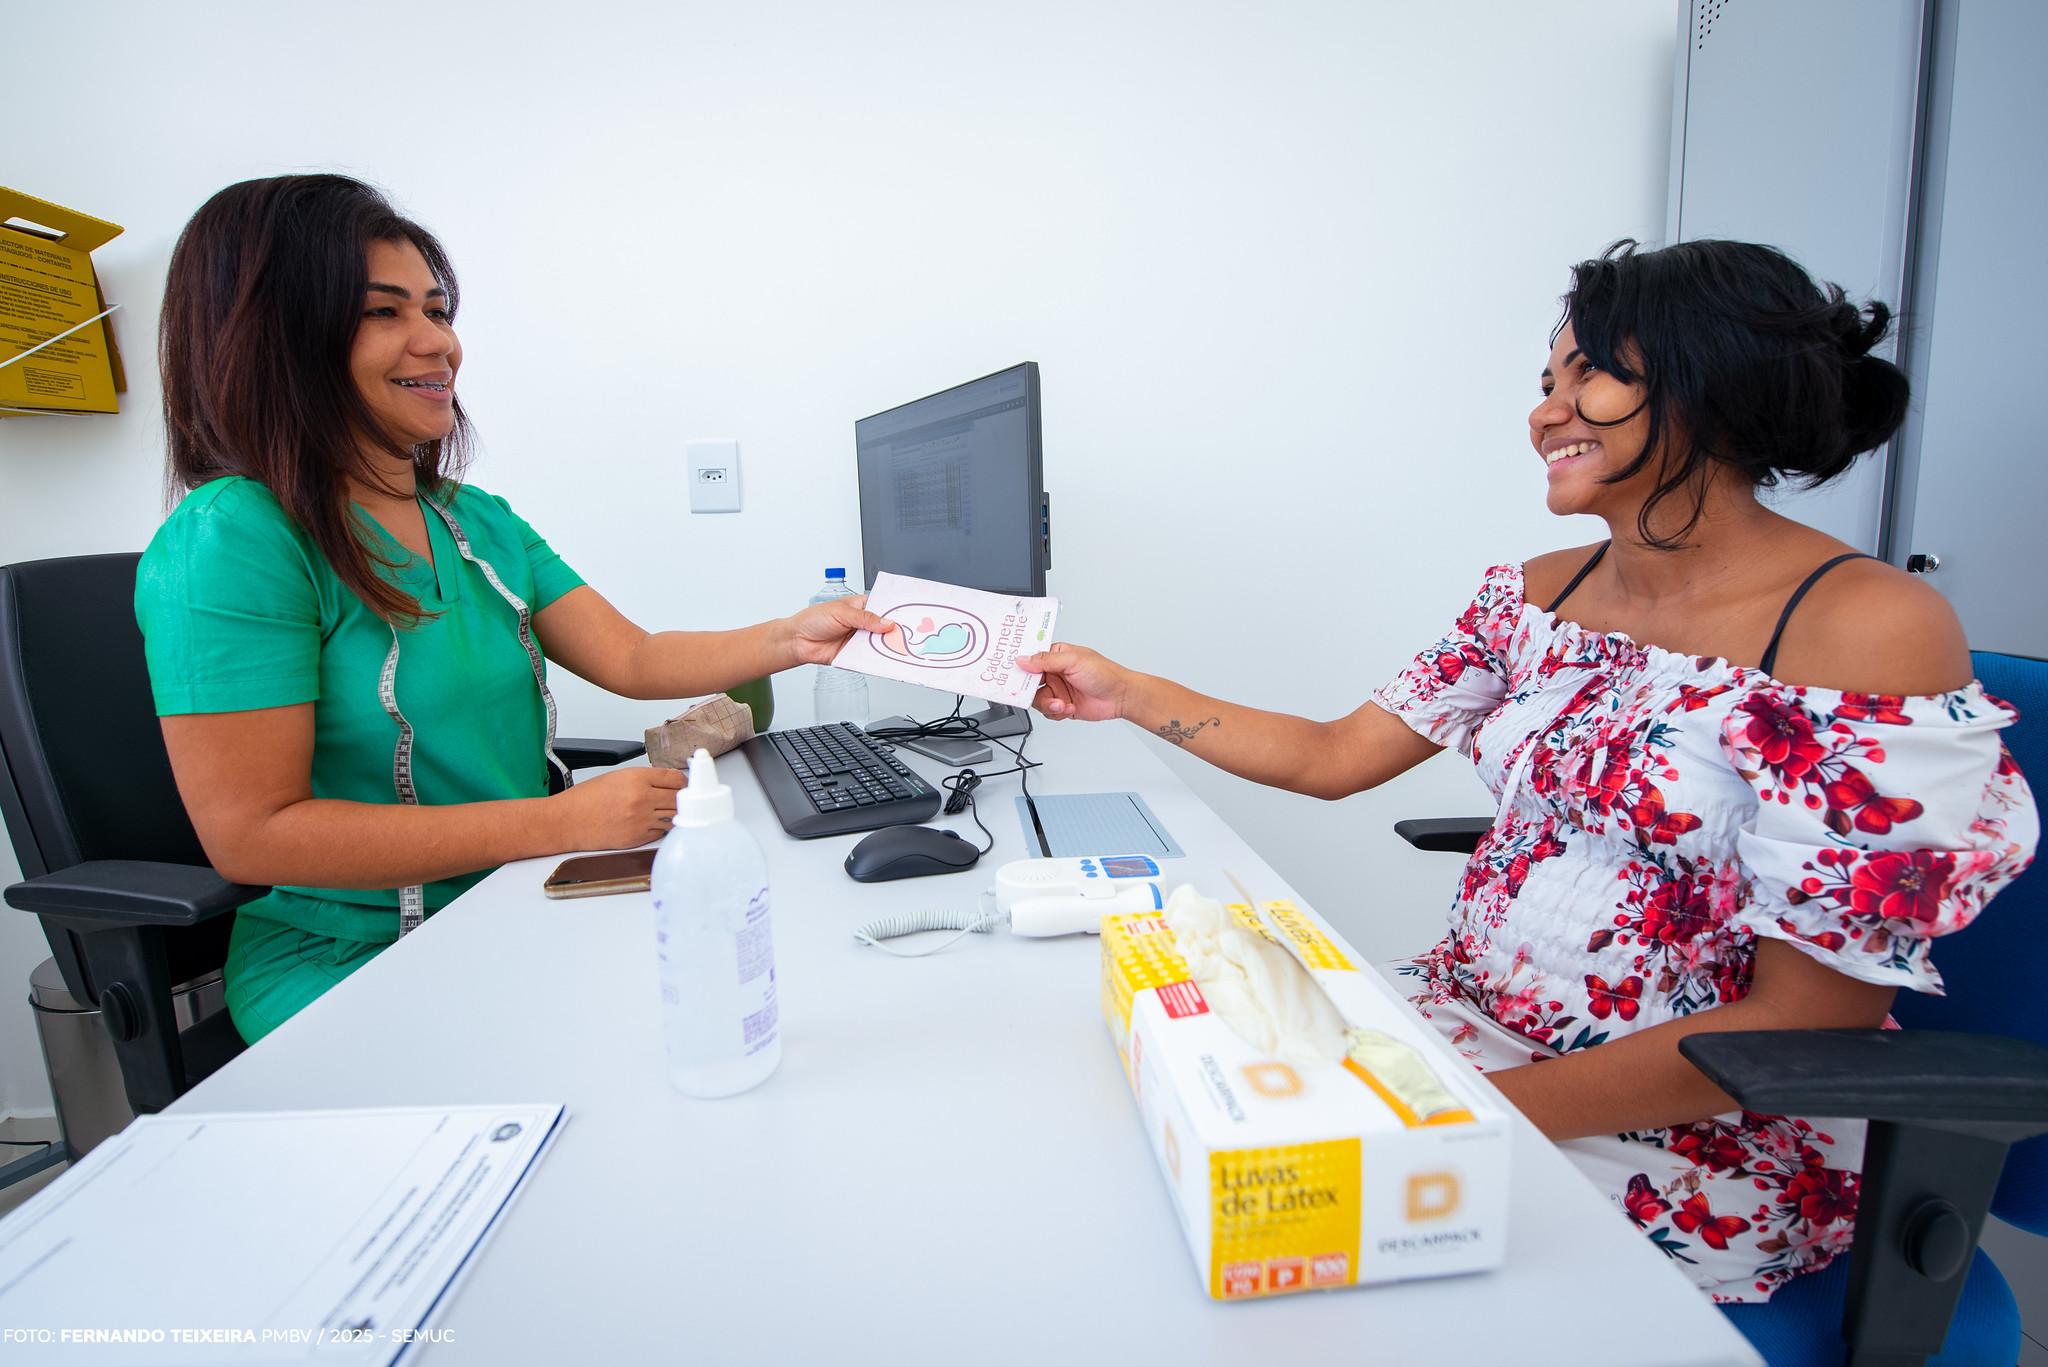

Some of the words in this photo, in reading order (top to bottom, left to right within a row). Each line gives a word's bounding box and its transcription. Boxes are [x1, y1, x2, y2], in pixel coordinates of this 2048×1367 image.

[0, 246, 33, 260] TIAGUDOS
[38, 256, 73, 270] CORTANTES
[25, 245, 33, 253] DE
[35, 249, 71, 263] MATERIALES
[980, 614, 1016, 682] Caderneta
[1001, 615, 1028, 670] Gestante
[994, 673, 1009, 686] da
[1221, 1163, 1299, 1190] Luvas
[1221, 1189, 1258, 1218] de
